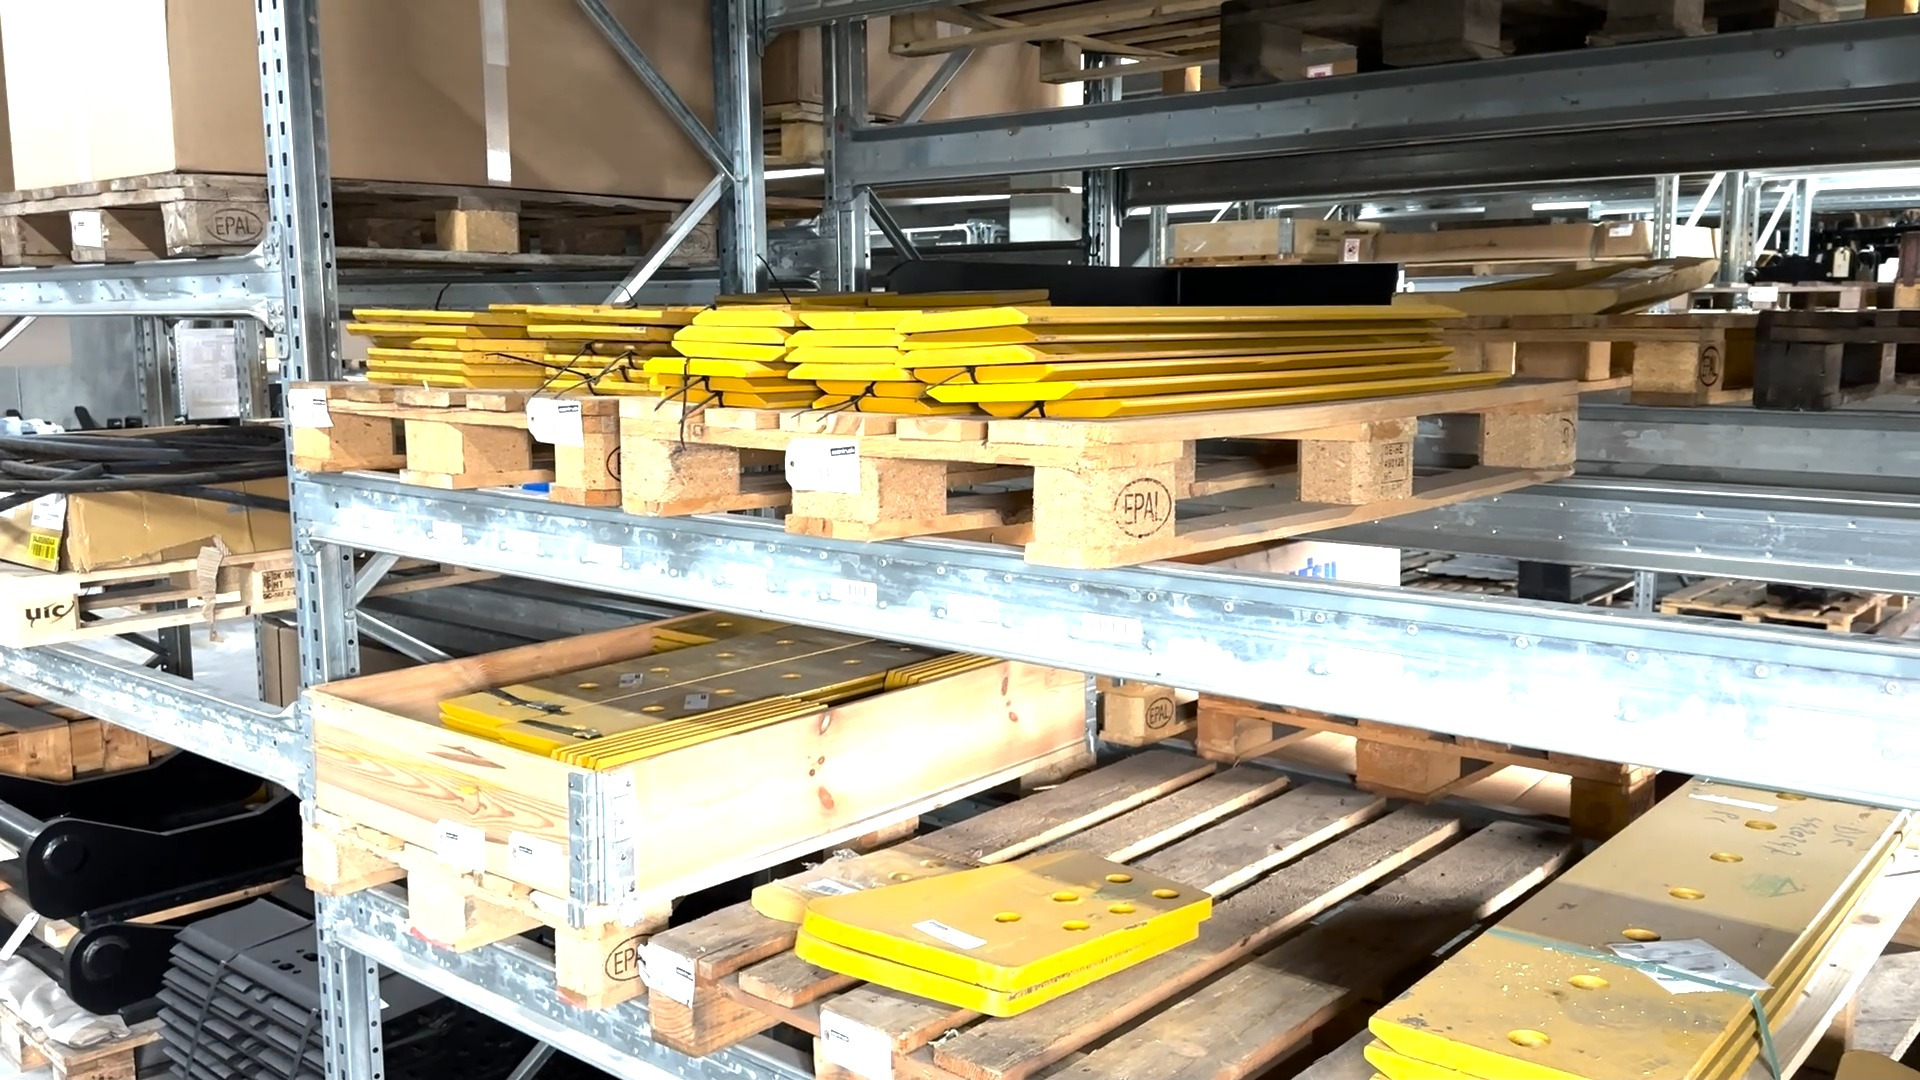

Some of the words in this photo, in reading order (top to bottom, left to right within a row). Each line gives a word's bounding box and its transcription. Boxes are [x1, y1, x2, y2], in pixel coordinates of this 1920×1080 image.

[214, 215, 256, 236] EPAL
[1124, 491, 1163, 525] EPAL
[1150, 703, 1170, 725] EPAL
[613, 947, 644, 976] EPA
